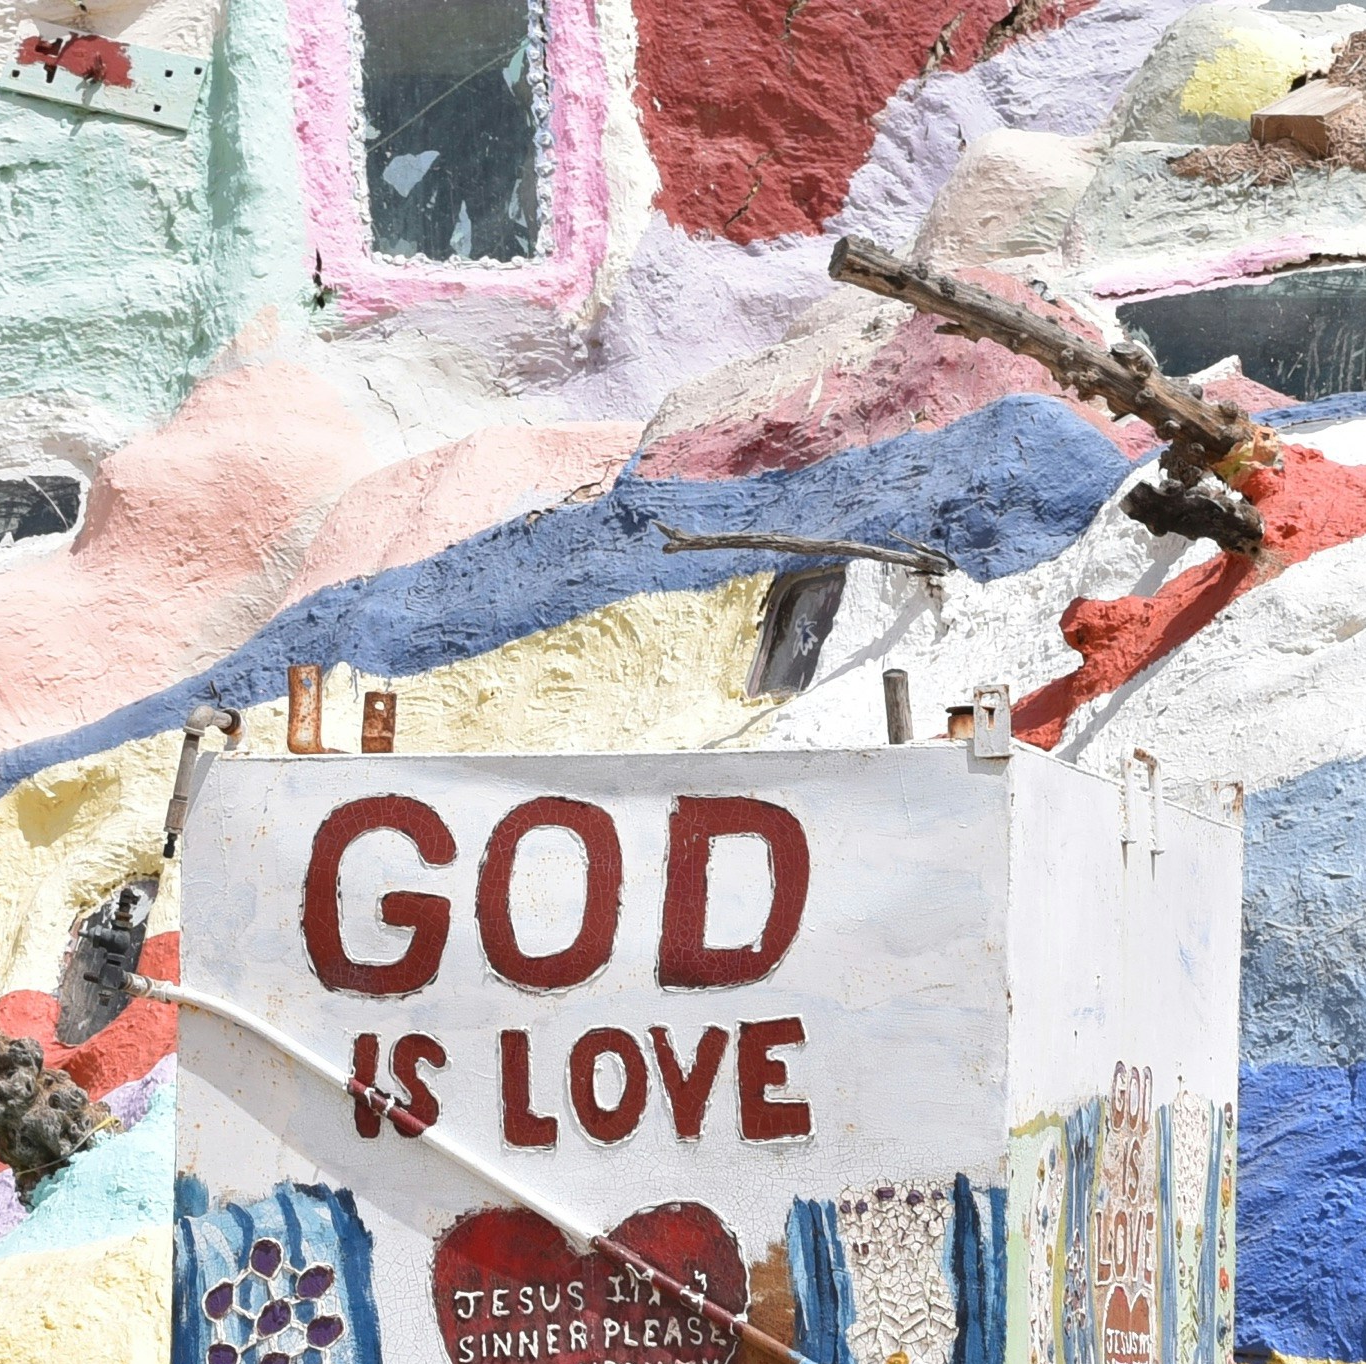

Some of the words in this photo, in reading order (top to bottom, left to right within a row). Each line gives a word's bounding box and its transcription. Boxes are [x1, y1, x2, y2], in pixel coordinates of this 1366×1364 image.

[299, 791, 812, 999] GOD
[348, 1029, 451, 1139] IS
[497, 1013, 817, 1152] LOVE
[1121, 1136, 1143, 1204] IS
[1094, 1207, 1157, 1290] LOVE
[453, 1280, 585, 1320] JESUS
[457, 1319, 589, 1364] SINNER
[602, 1315, 729, 1349] PLEASE
[1105, 1326, 1138, 1355] JESUS
